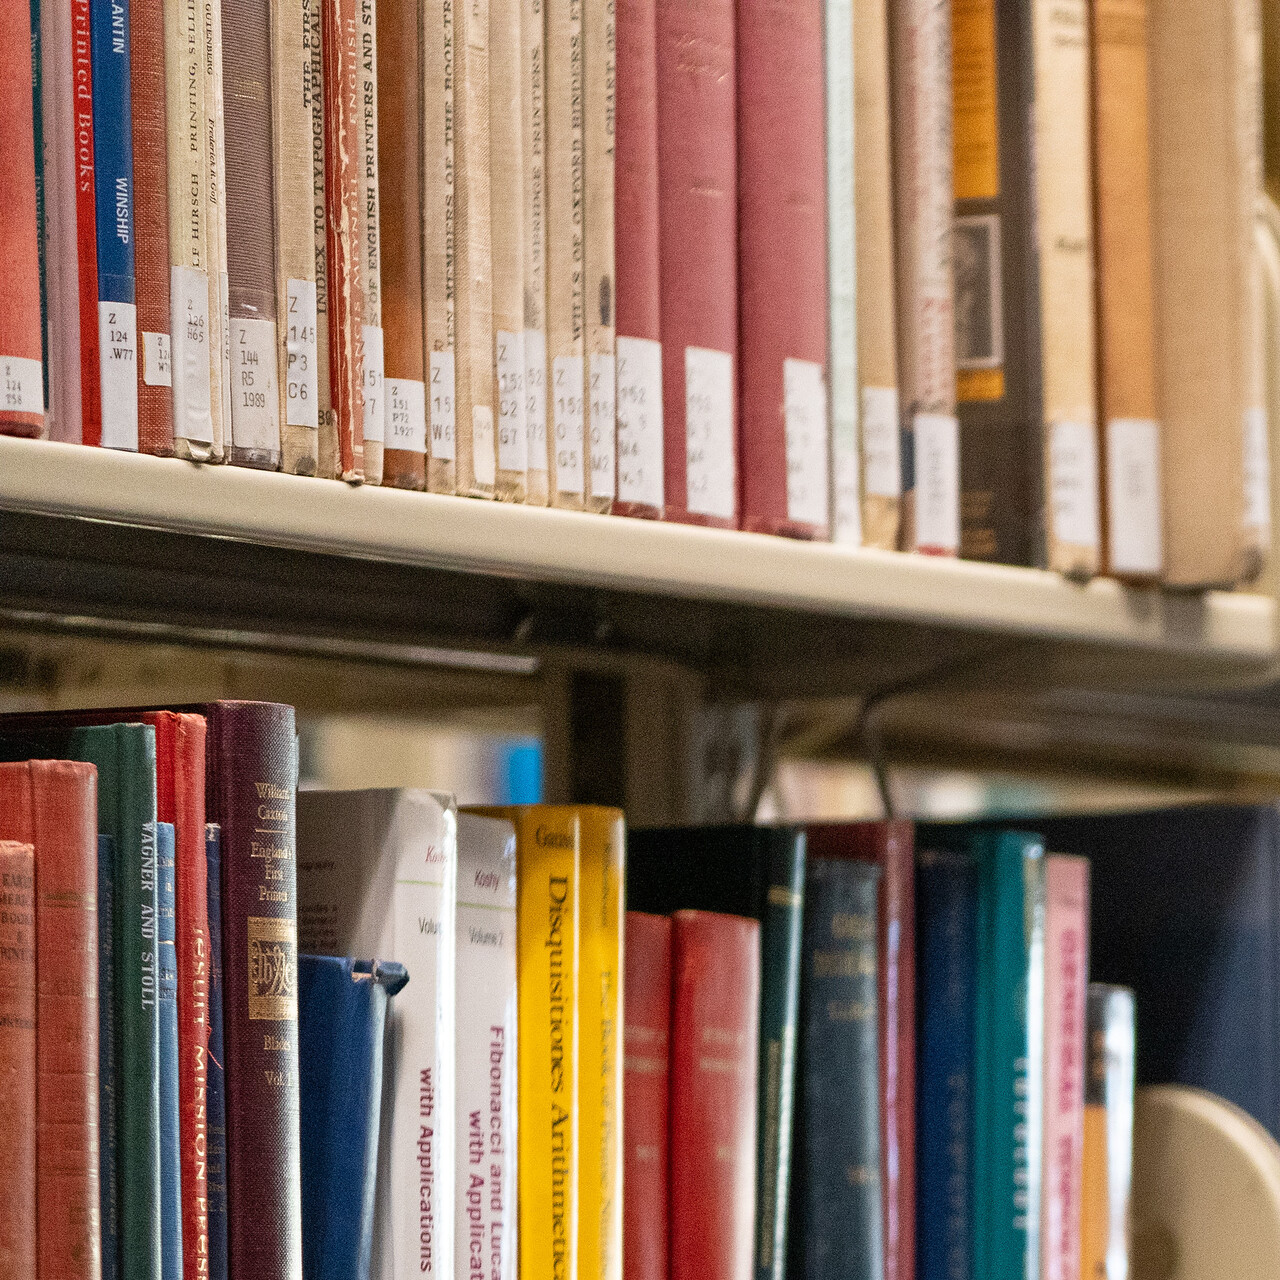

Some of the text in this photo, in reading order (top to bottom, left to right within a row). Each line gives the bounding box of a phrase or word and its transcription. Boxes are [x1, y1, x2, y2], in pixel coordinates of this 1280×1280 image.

[111, 0, 124, 53] ANTIN
[205, 3, 214, 75] GUTENBERG
[347, 19, 358, 124] ENGLISH
[362, 33, 373, 73] AND
[76, 0, 94, 192] Printed Books
[303, 62, 312, 108] THE
[187, 0, 200, 240] HIRSCH PRINTING, SELLI
[208, 118, 216, 166] Frederick
[363, 81, 376, 178] PRINTERS
[444, 101, 453, 147] THE
[311, 5, 326, 314] INDEX TO TYPOGRAPHICAL
[209, 182, 218, 205] Goff
[571, 140, 583, 225] OXFORD
[116, 177, 129, 244] WINSHIP
[365, 188, 378, 270] ENGLISH
[108, 313, 117, 324] Z
[188, 314, 204, 327] 126
[289, 297, 298, 314] Z
[109, 348, 134, 360] .W77
[110, 331, 128, 342] 124
[187, 327, 204, 343] H65
[240, 330, 247, 345] Z
[290, 326, 316, 344] 145
[241, 351, 259, 366] 144
[241, 371, 255, 387] R5
[432, 367, 441, 384] Z
[556, 369, 565, 386] Z
[242, 392, 266, 409] 1989
[392, 386, 398, 396] Z
[393, 399, 408, 411] 151
[392, 412, 409, 423] P72
[394, 425, 414, 437] 1927
[141, 822, 155, 1011] WAGNER AND STOLL
[545, 874, 570, 1094] Disquisitiones
[490, 1025, 505, 1155] Fibonacci
[194, 1045, 206, 1180] MISSION
[469, 1110, 483, 1165] with
[416, 1067, 434, 1273] with Applications
[490, 1165, 504, 1209] and
